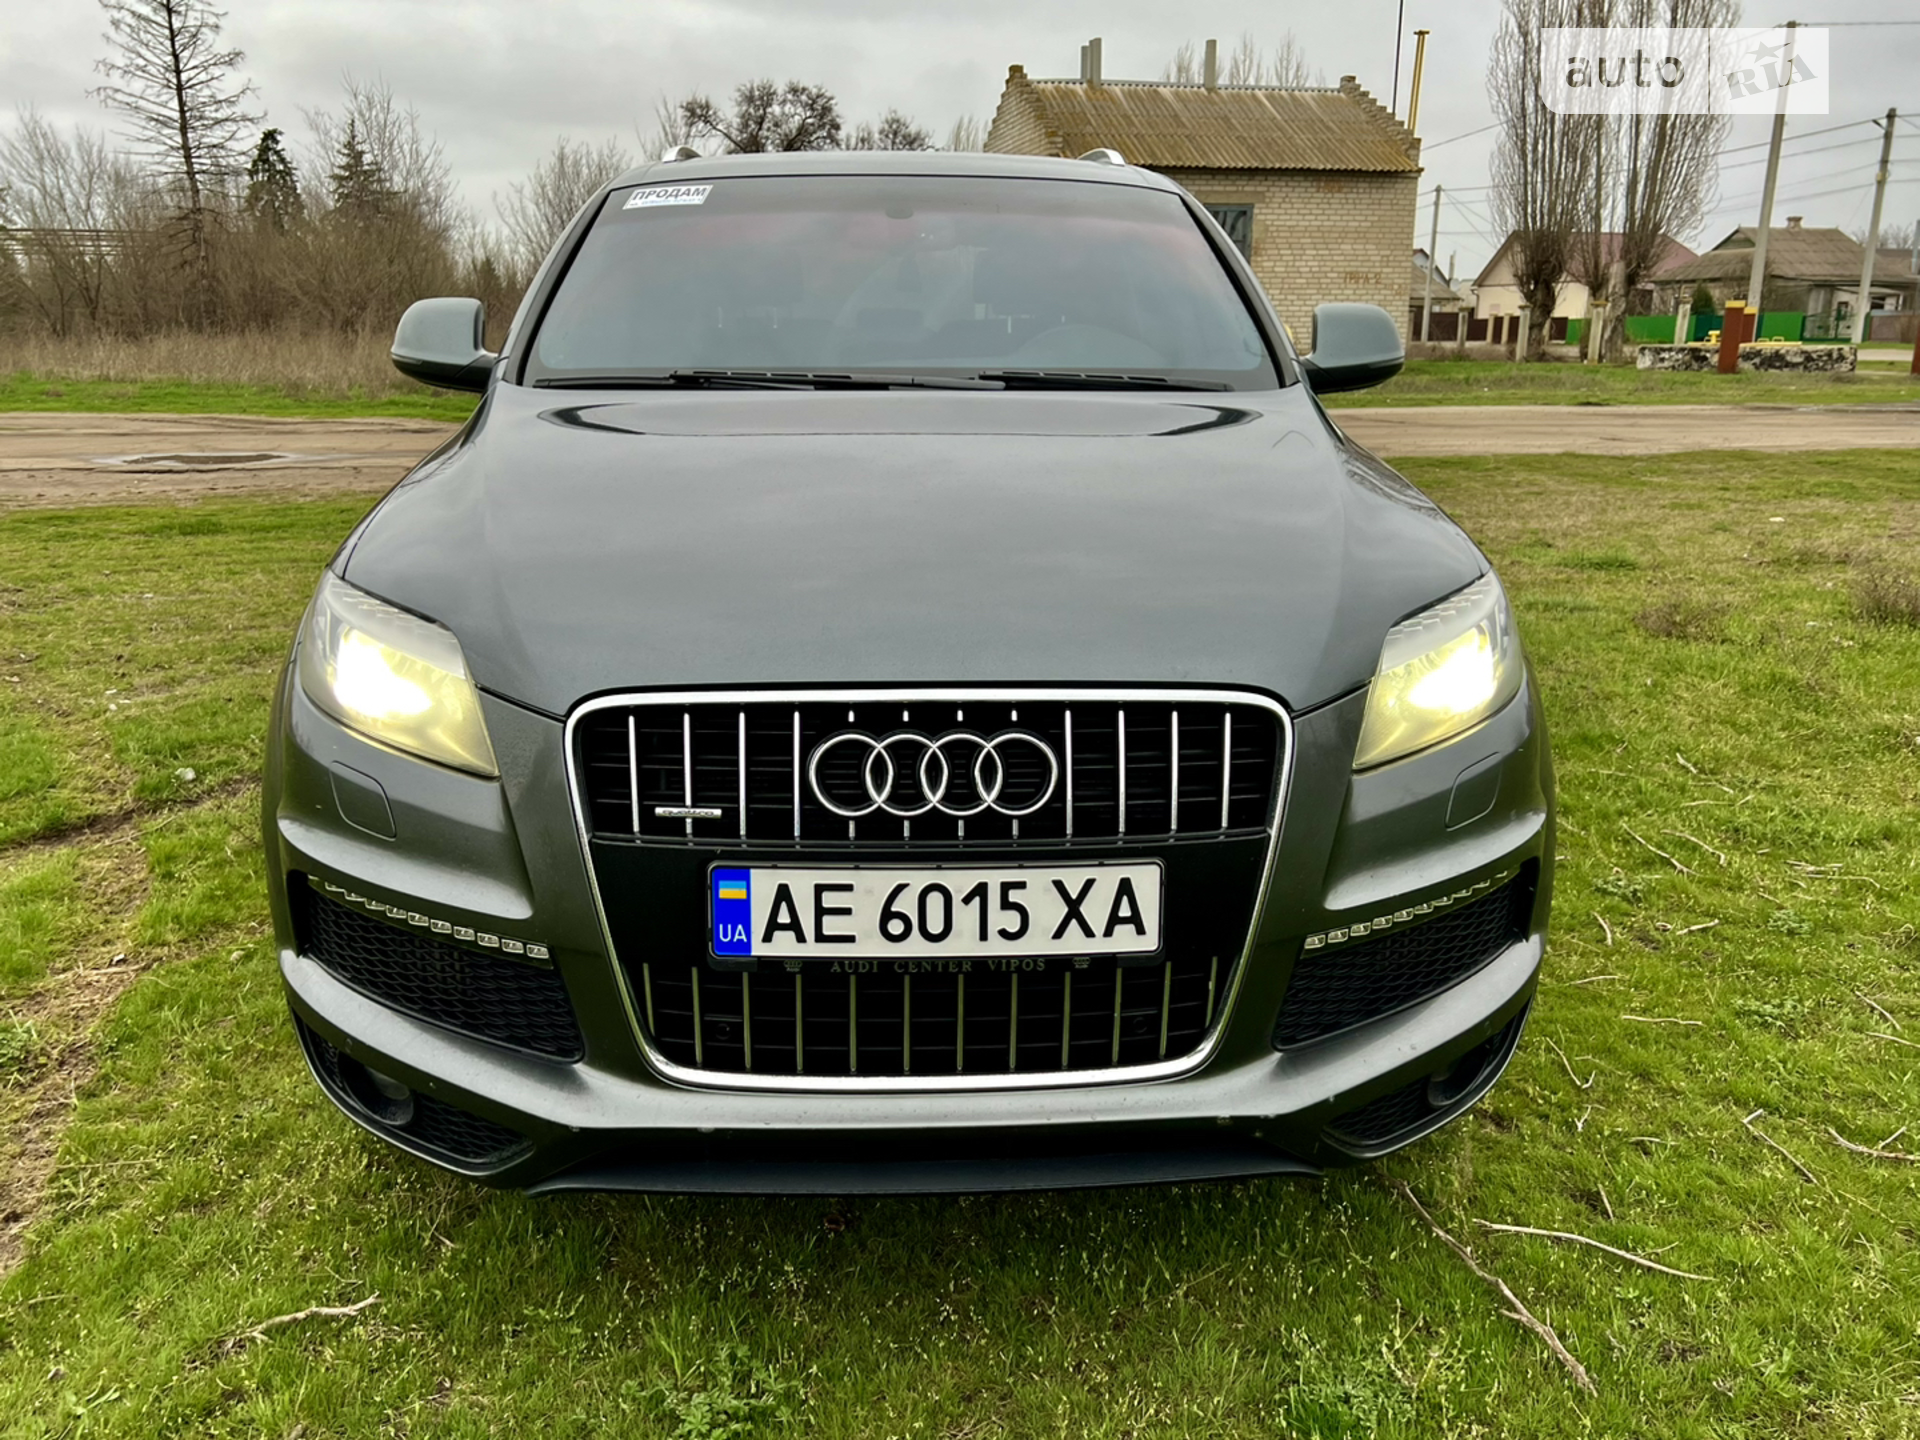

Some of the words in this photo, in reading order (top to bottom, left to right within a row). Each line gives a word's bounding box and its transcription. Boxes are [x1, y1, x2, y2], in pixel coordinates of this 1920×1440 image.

[632, 187, 707, 200] ПРОДАМ
[663, 809, 714, 817] quattro
[761, 883, 856, 943] AE
[878, 880, 1030, 943] 6015
[1051, 877, 1147, 940] XA
[719, 924, 748, 943] UA
[830, 960, 878, 973] AUDI
[894, 960, 973, 973] CENTER
[988, 958, 1046, 971] VIPOS
